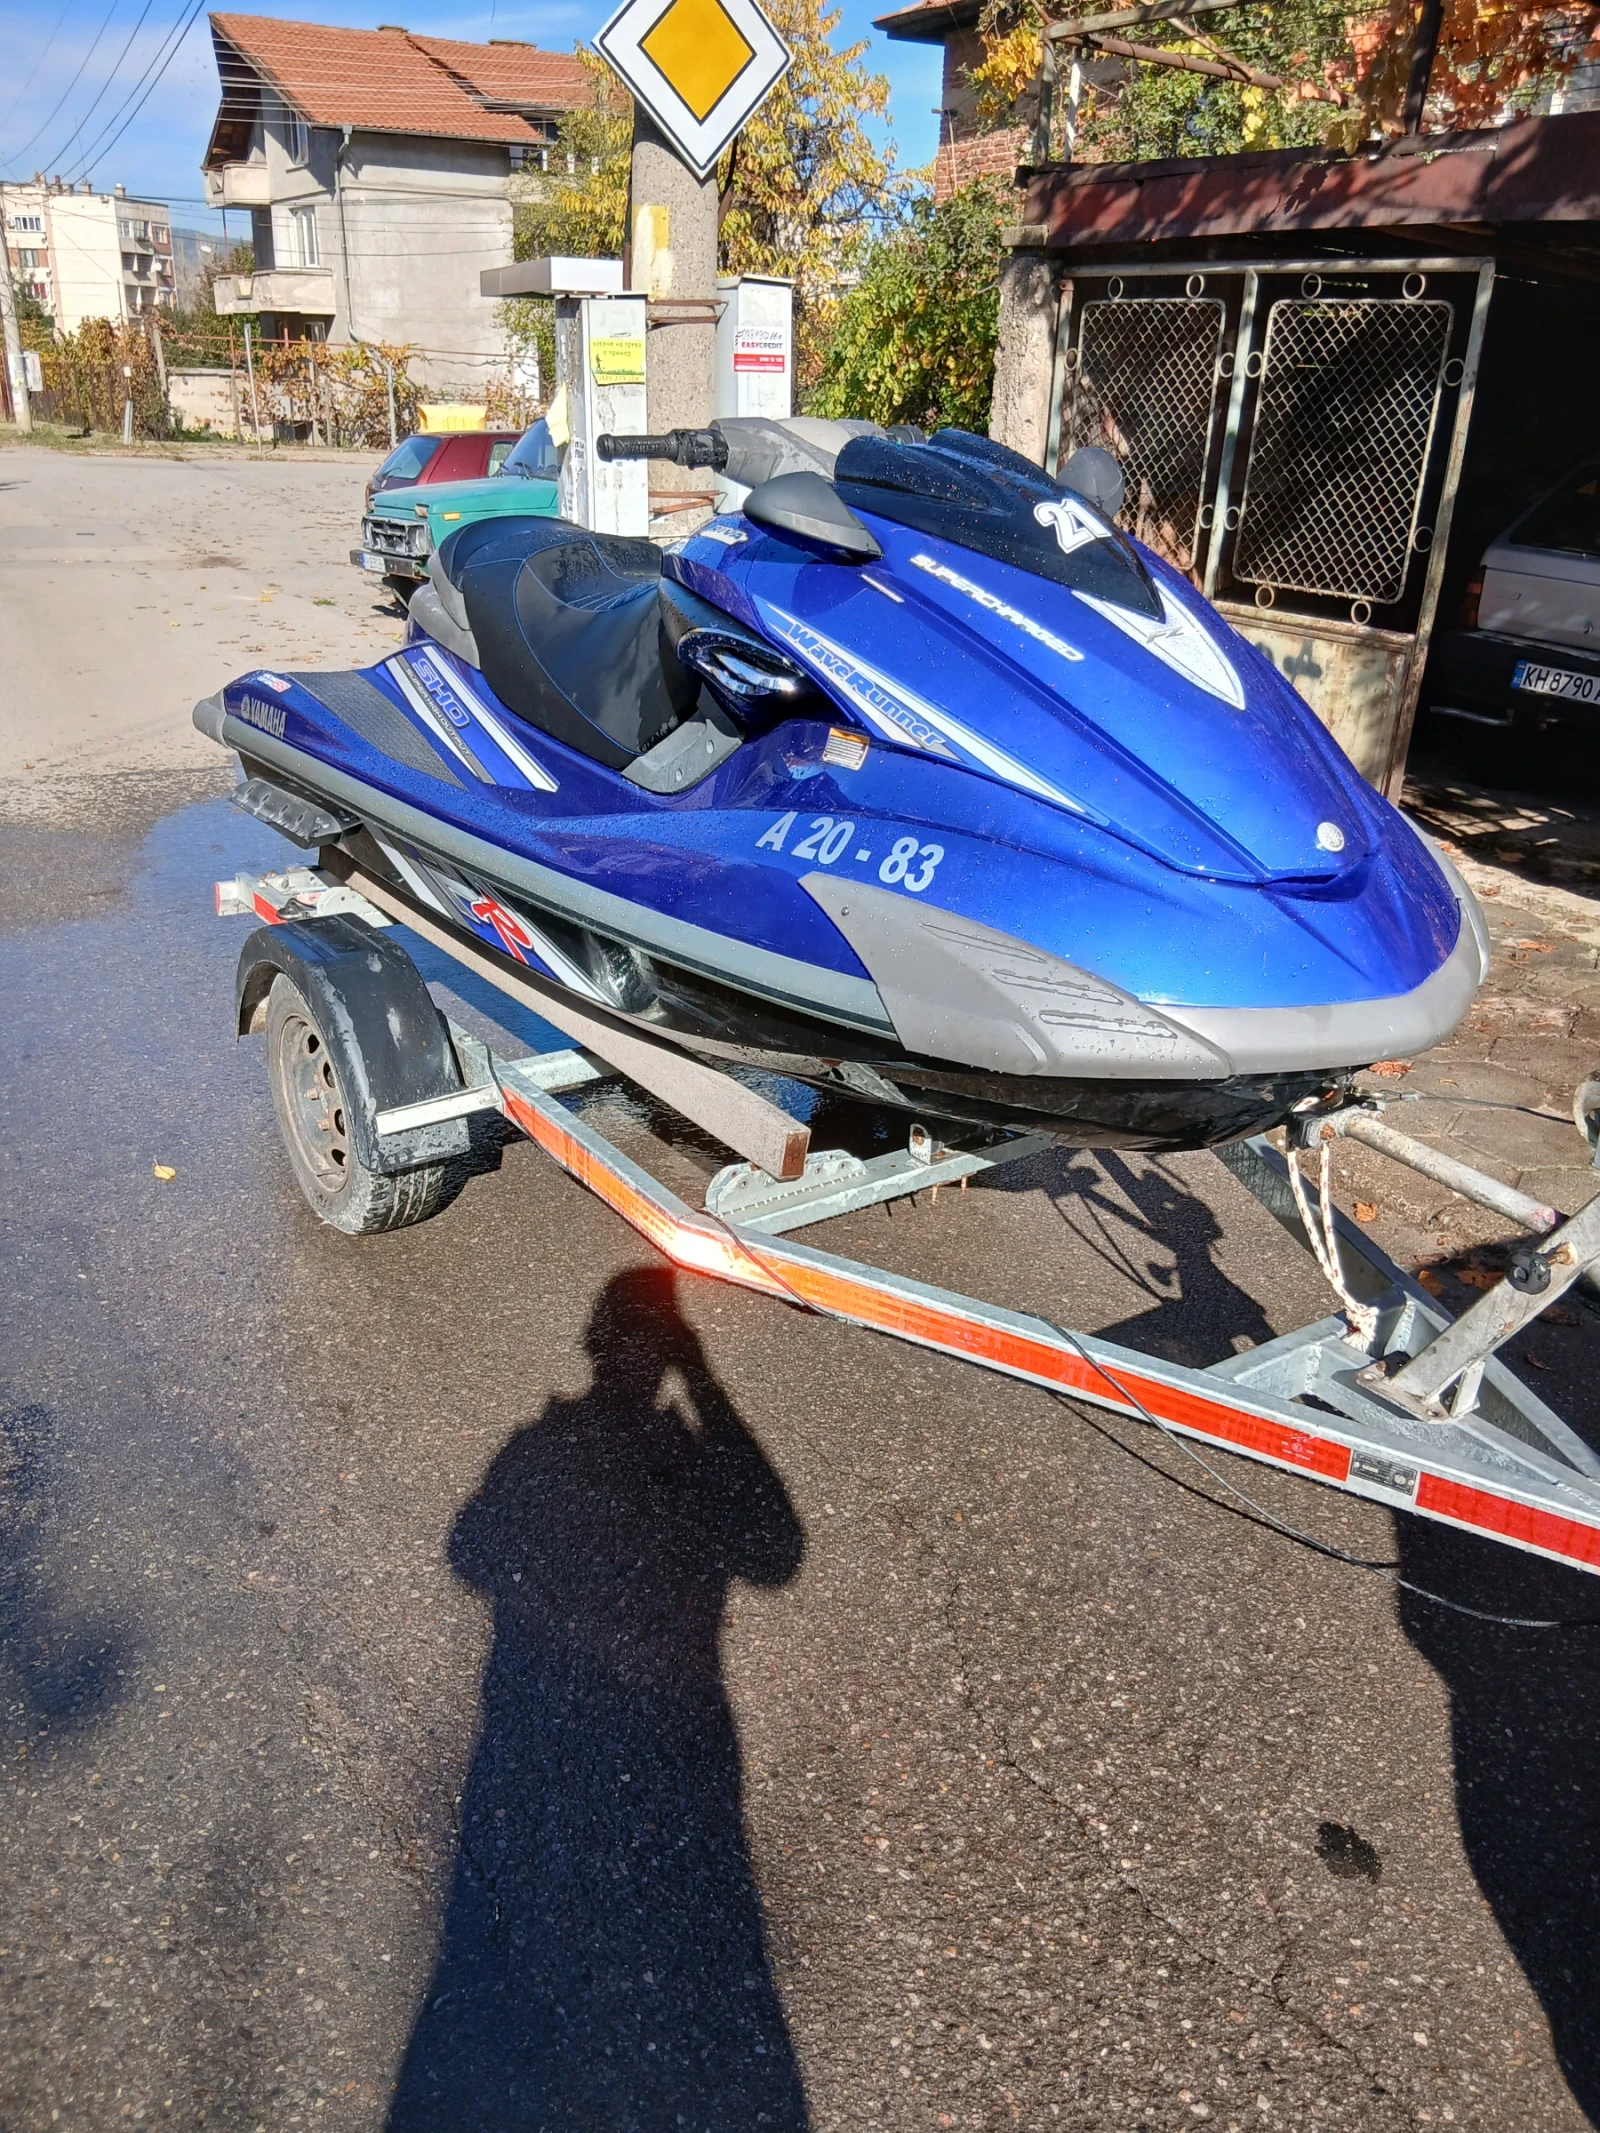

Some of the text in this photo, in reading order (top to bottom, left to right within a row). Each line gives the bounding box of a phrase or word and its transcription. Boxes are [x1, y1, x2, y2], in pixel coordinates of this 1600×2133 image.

[741, 341, 783, 349] EASYCREDIT
[909, 553, 1086, 663] SUPERCHARGED
[251, 697, 287, 740] YAMAHA
[405, 668, 428, 699] SUPER
[440, 716, 473, 757] OUTPUT
[411, 658, 470, 728] SHO
[788, 623, 947, 747] WaveRunner
[755, 811, 799, 852] A
[791, 816, 855, 865] 20
[879, 836, 944, 893] 83
